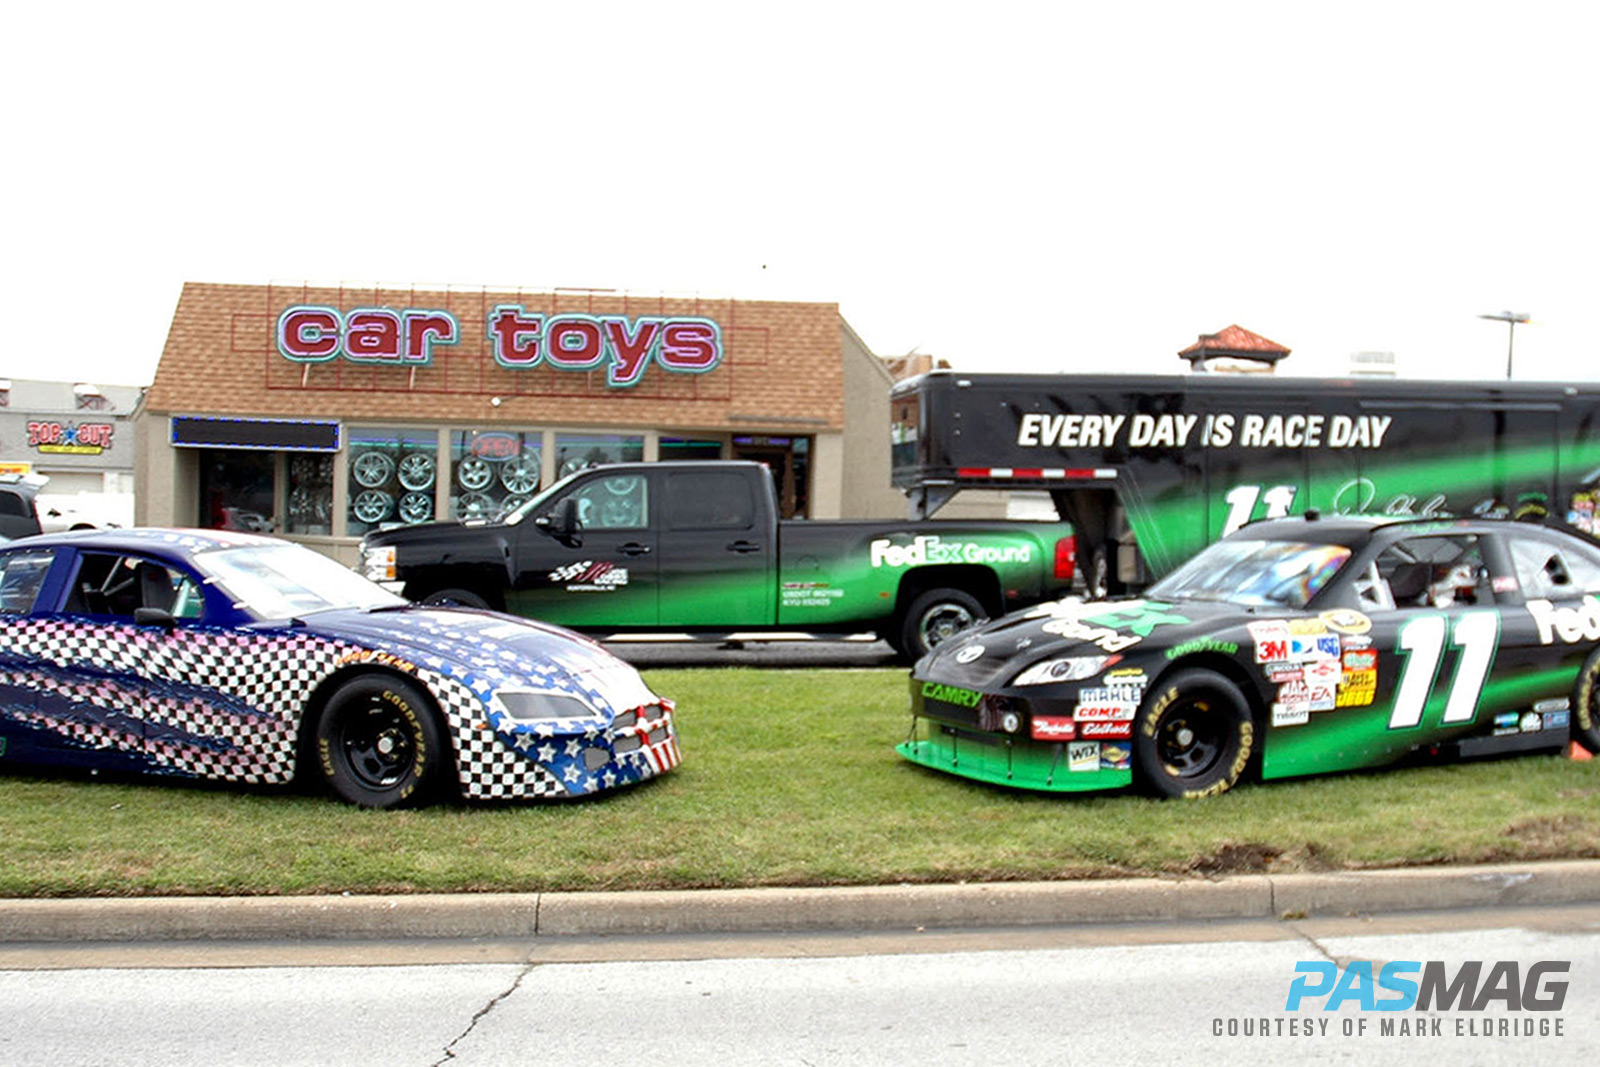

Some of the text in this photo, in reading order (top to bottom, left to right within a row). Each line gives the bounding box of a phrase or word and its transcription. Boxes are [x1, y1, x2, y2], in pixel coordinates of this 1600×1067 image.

[277, 303, 723, 388] car toys
[27, 421, 113, 448] TOP CUT
[1018, 414, 1392, 448] EVERY DAY IS RACE DAY
[870, 536, 1030, 567] FedEx Ground
[1164, 636, 1239, 661] GOODYEAR
[1258, 639, 1288, 661] 3M
[1317, 637, 1339, 658] USG
[1387, 610, 1500, 729] 11
[921, 681, 984, 709] CAMRY
[1081, 687, 1140, 703] MAHLE
[1078, 707, 1122, 718] COMP
[1142, 686, 1179, 737] EAGLE
[383, 690, 427, 778] GOODYEAR
[1070, 744, 1097, 761] WIX
